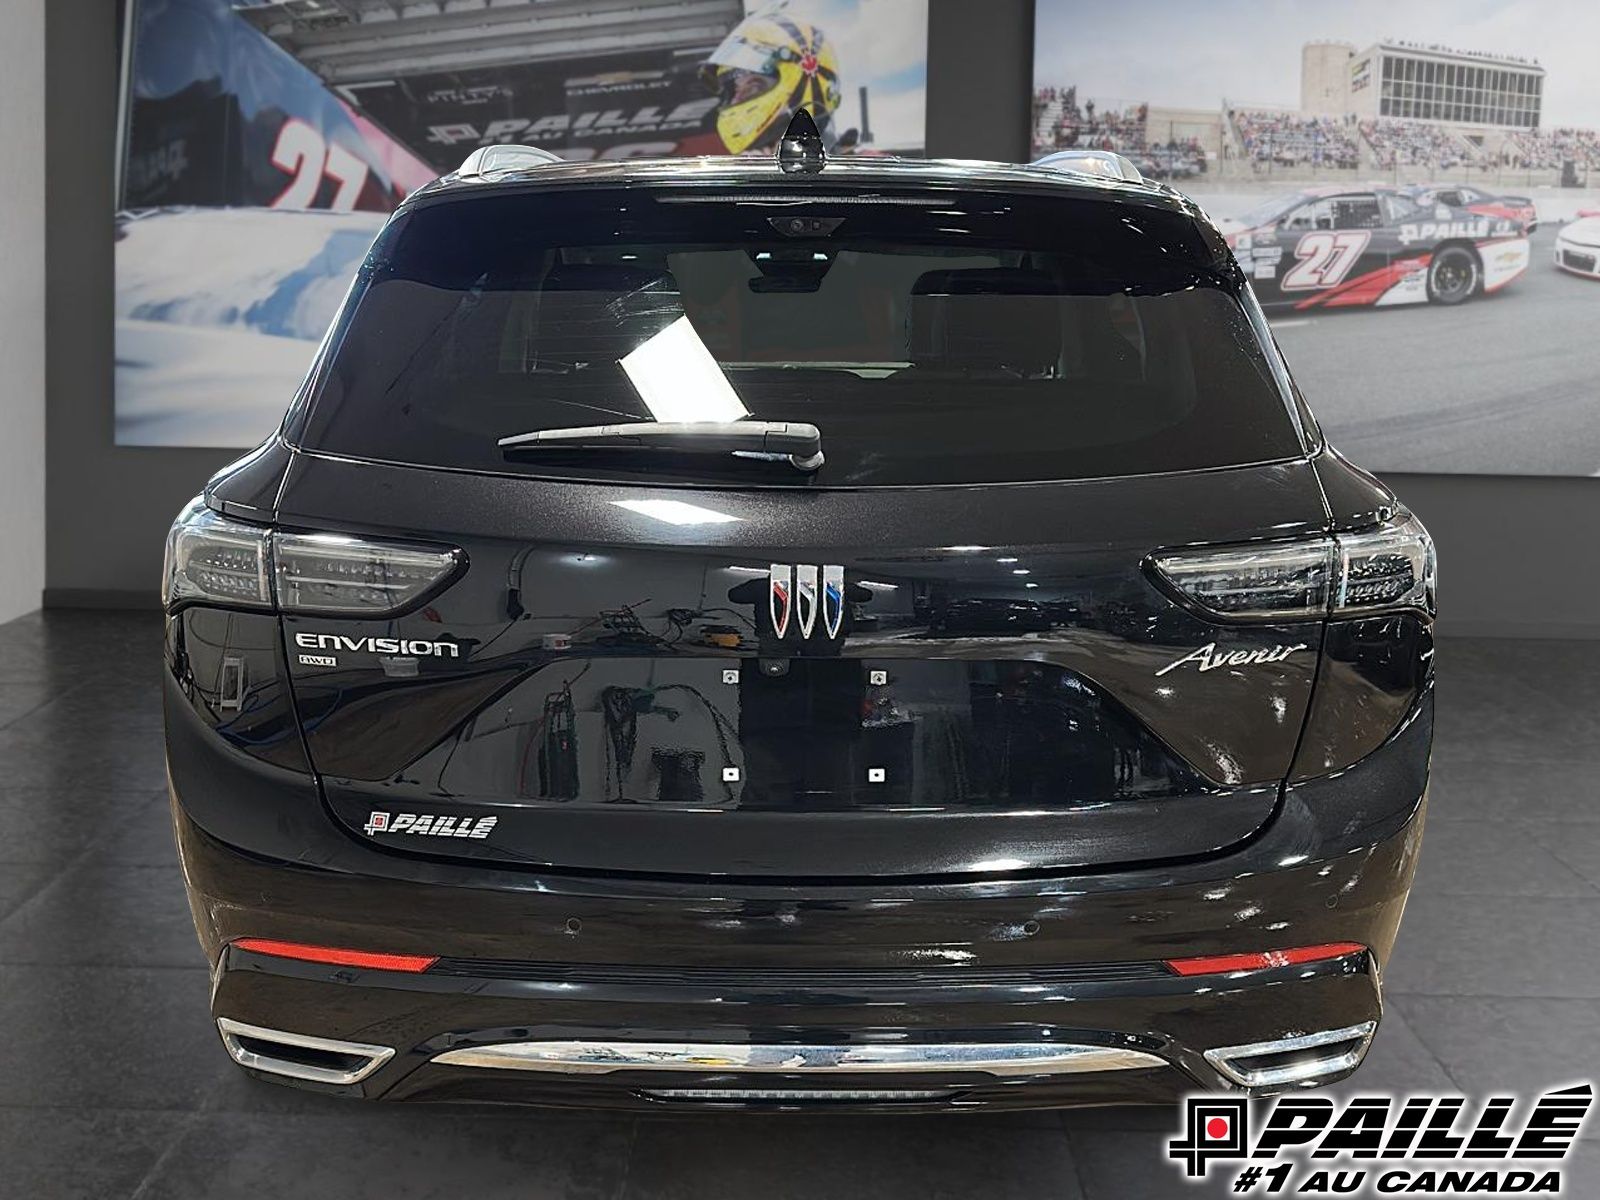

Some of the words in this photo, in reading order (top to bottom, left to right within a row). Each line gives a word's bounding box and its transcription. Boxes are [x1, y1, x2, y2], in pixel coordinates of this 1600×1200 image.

[574, 121, 702, 138] CANADA
[1281, 230, 1372, 292] 27
[295, 632, 459, 657] ENVISION
[298, 654, 337, 667] AWD
[1155, 642, 1308, 676] Avenir
[388, 813, 498, 838] PAILLÉ
